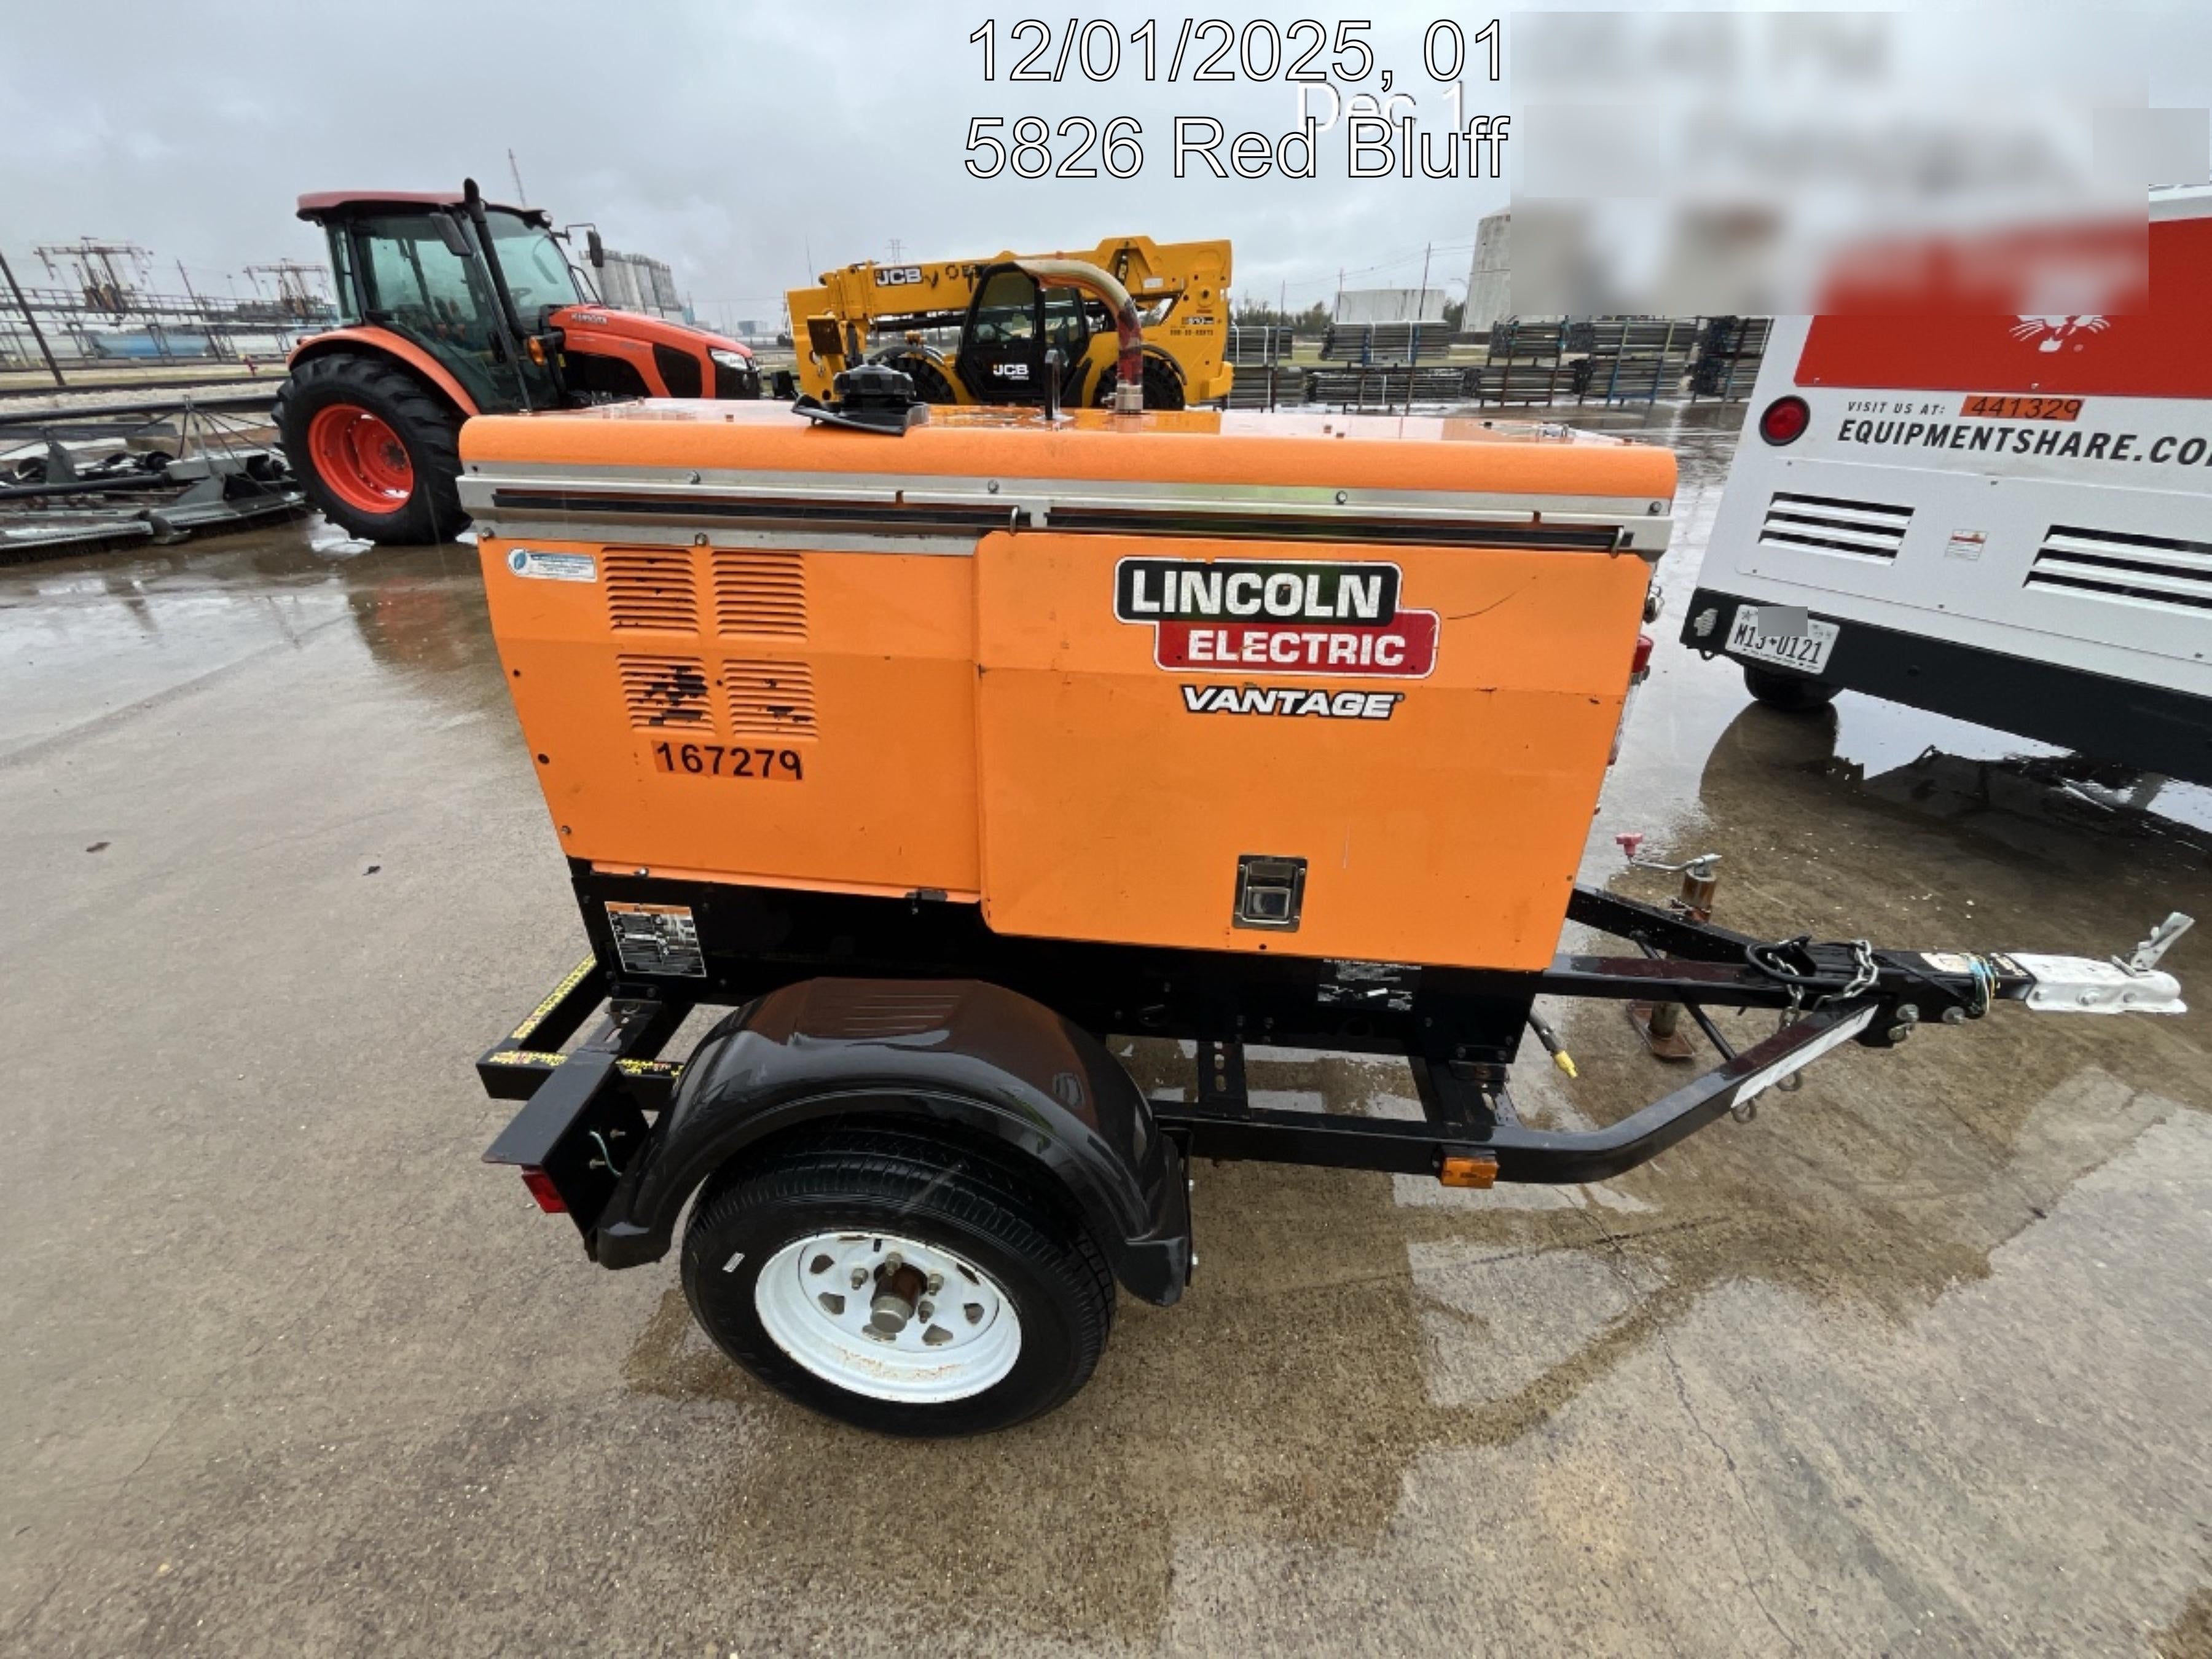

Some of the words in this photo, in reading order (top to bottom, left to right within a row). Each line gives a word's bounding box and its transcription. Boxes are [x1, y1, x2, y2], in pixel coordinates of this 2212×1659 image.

[876, 268, 922, 286] JCB
[993, 364, 1029, 376] JCB
[1847, 401, 1888, 413] VISIT
[1894, 404, 1913, 414] US
[1920, 405, 1947, 415] AT:
[1972, 396, 2082, 420] 441329
[1837, 418, 2212, 466] EQUIPMENTSHARE.CO
[1132, 569, 1382, 618] LINCOLN
[1188, 629, 1406, 667] ELECTRIC
[657, 741, 804, 780] 167279
